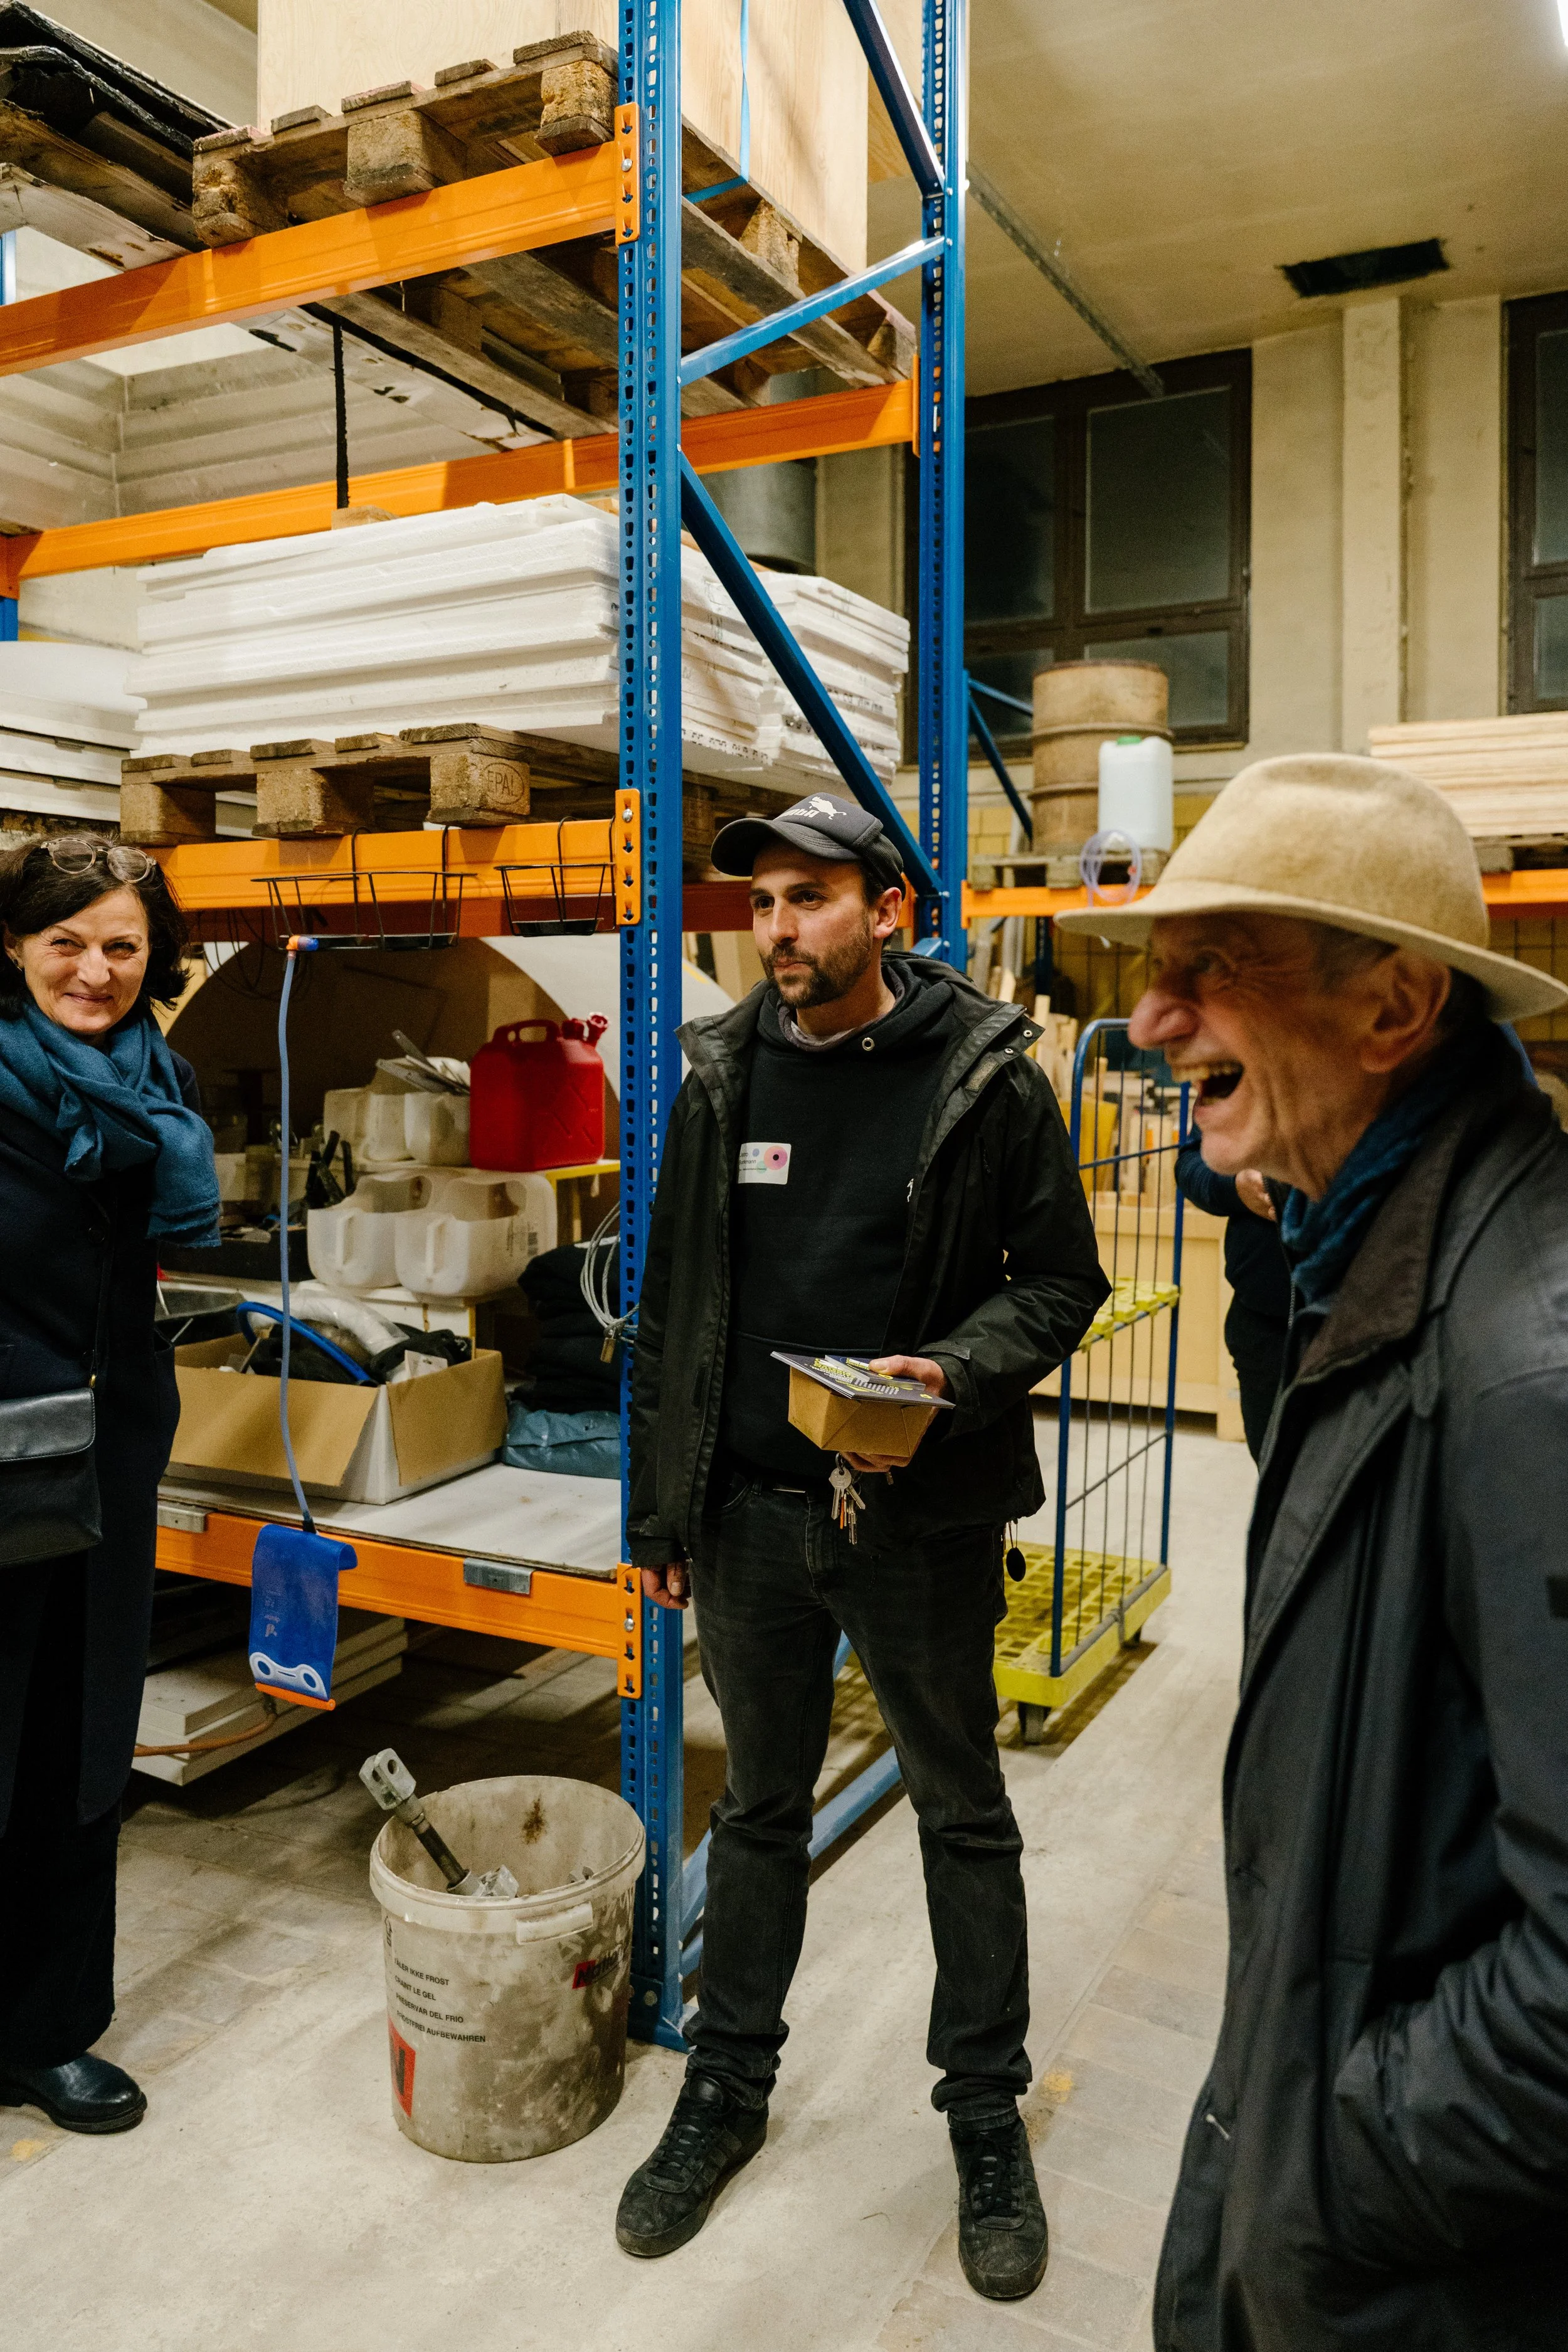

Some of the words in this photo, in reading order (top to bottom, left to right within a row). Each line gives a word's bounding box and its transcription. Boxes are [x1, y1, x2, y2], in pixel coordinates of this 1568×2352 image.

[410, 1968, 424, 1979] IKKE
[425, 1974, 449, 1986] FROST
[413, 1985, 421, 1996] LE
[422, 1991, 437, 2001] GEL
[396, 1992, 428, 2015] PRESERVAR
[429, 2011, 443, 2020] DEL
[445, 2015, 464, 2023] FRIO
[426, 2028, 486, 2043] AUFBEWAHREN
